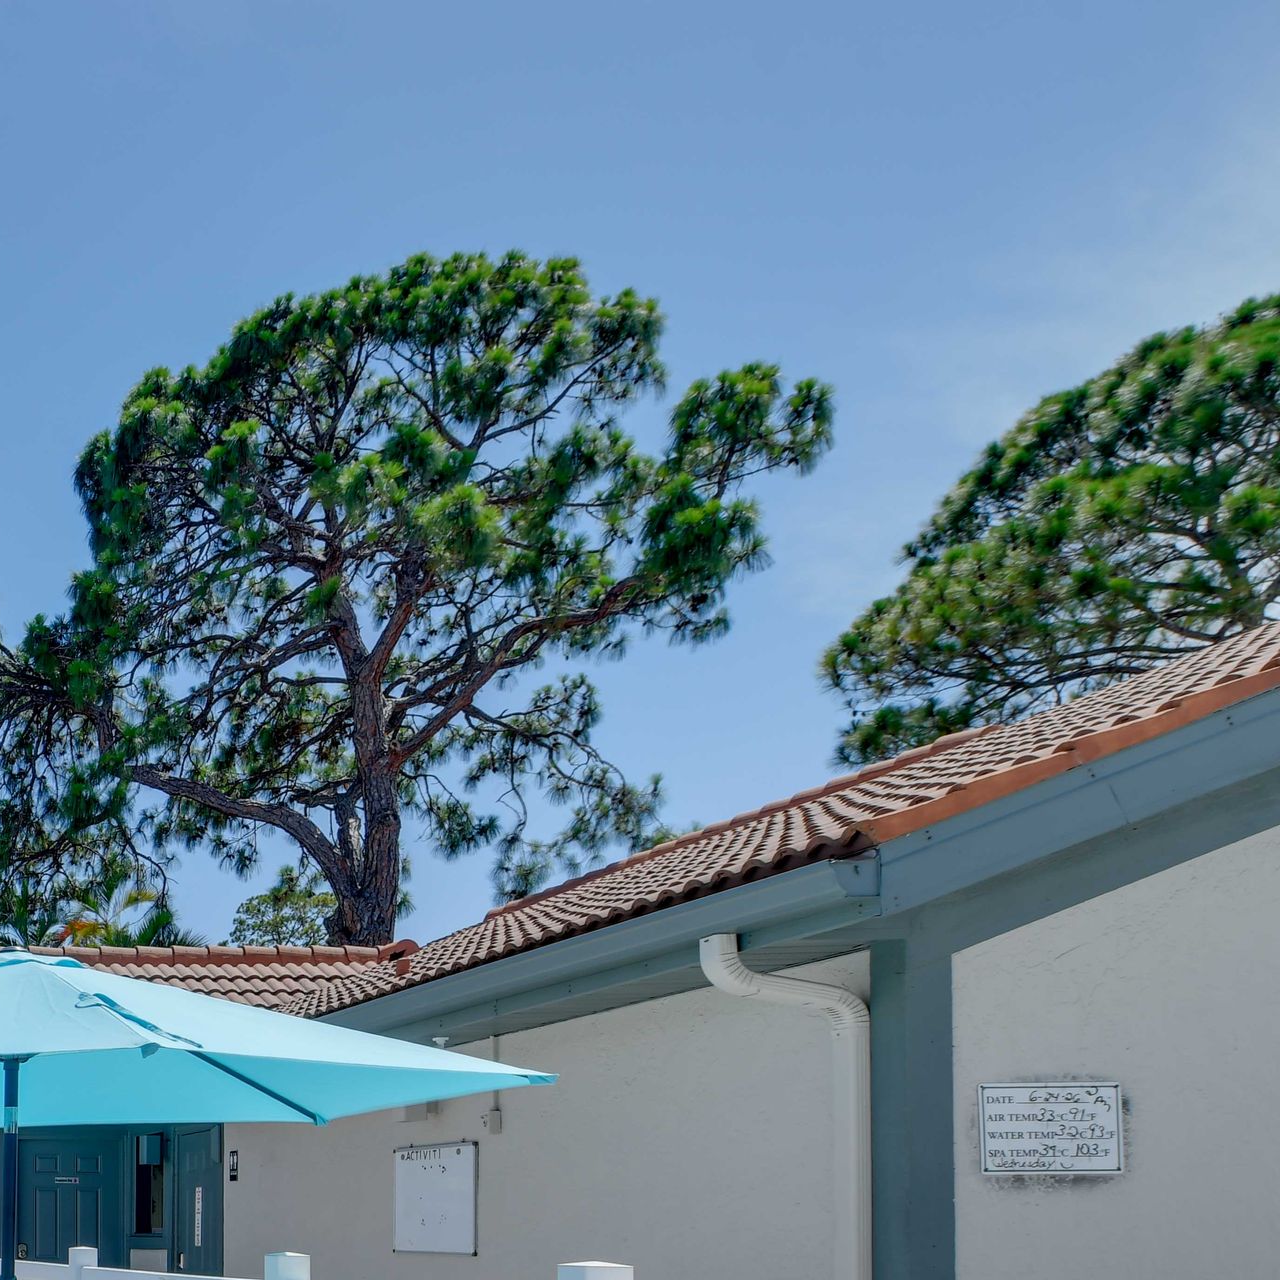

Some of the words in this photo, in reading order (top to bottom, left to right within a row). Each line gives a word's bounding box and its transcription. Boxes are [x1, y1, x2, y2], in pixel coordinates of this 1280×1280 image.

[986, 1096, 1014, 1104] DATE
[988, 1131, 1024, 1139] WATER
[1028, 1131, 1056, 1139] TEMP
